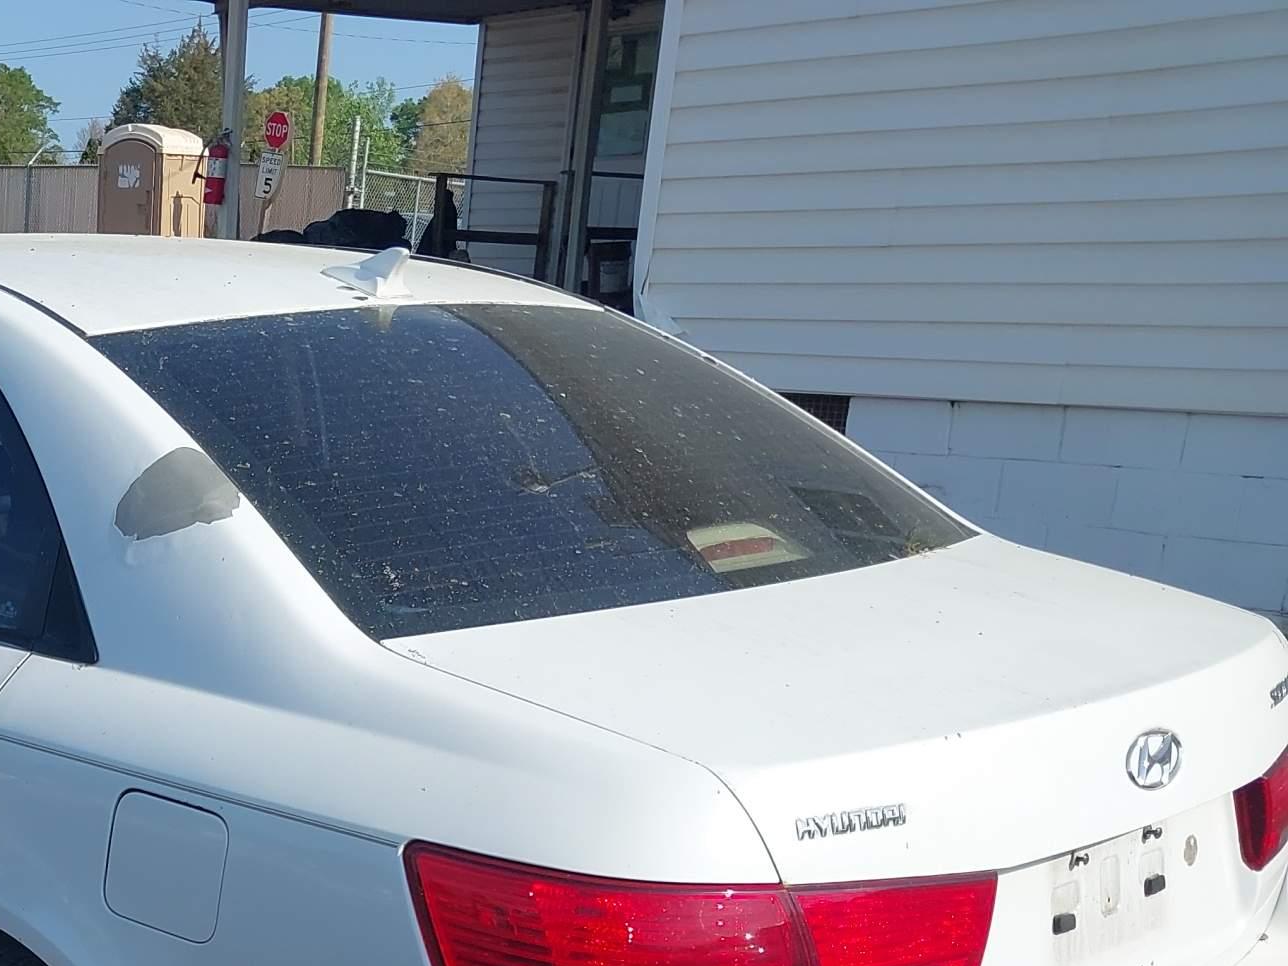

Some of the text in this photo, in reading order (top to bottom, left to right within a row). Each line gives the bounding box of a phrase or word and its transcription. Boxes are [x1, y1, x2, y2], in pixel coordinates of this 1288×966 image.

[266, 122, 288, 138] STOP
[262, 156, 281, 166] SPEED
[262, 166, 279, 175] LIMIT
[263, 177, 273, 194] 5
[795, 803, 906, 841] HYUNDAI
